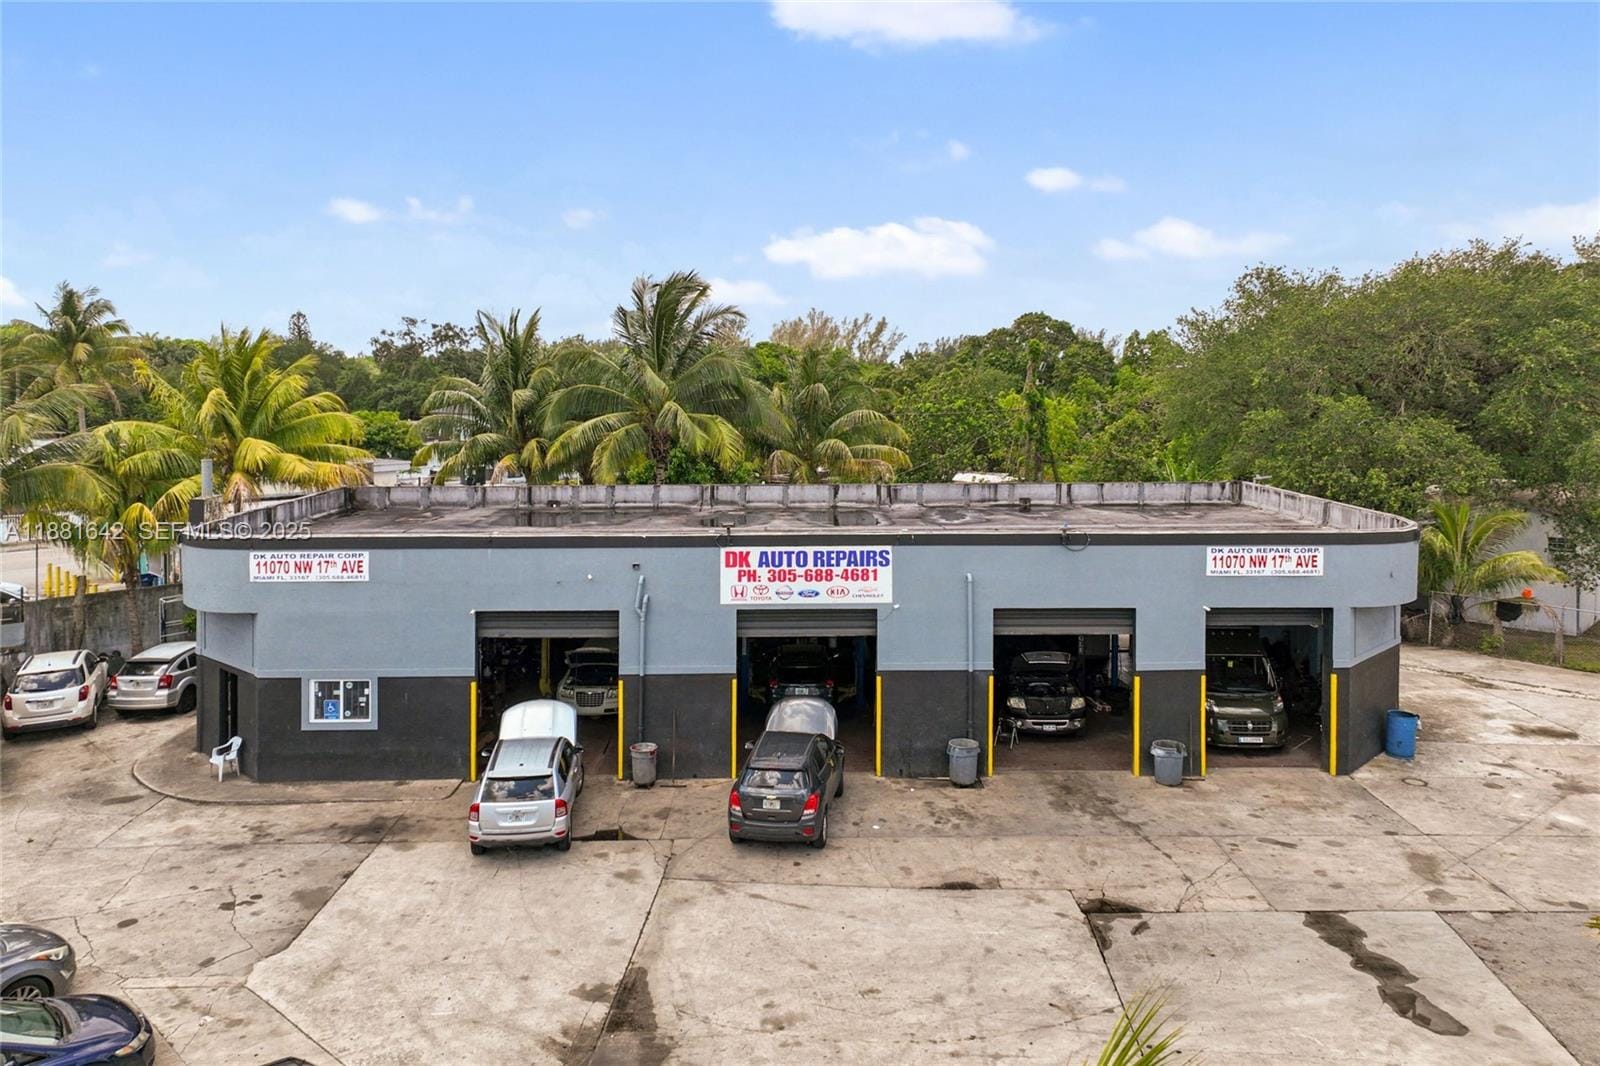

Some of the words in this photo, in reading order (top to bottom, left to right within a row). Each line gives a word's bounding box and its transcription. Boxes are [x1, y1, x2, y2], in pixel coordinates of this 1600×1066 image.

[724, 551, 751, 568] DK
[758, 550, 808, 568] AUTO
[812, 550, 890, 568] REPAIRS
[1212, 555, 1246, 568] 11070
[1249, 555, 1268, 568] NW
[1272, 555, 1292, 568] 17th
[1296, 555, 1318, 568] AVE
[256, 560, 290, 574] 11070
[294, 560, 313, 574] NW
[316, 560, 338, 574] 17th
[341, 560, 364, 574] AVE
[738, 569, 762, 582] PH:
[768, 568, 878, 582] 305-688-4681
